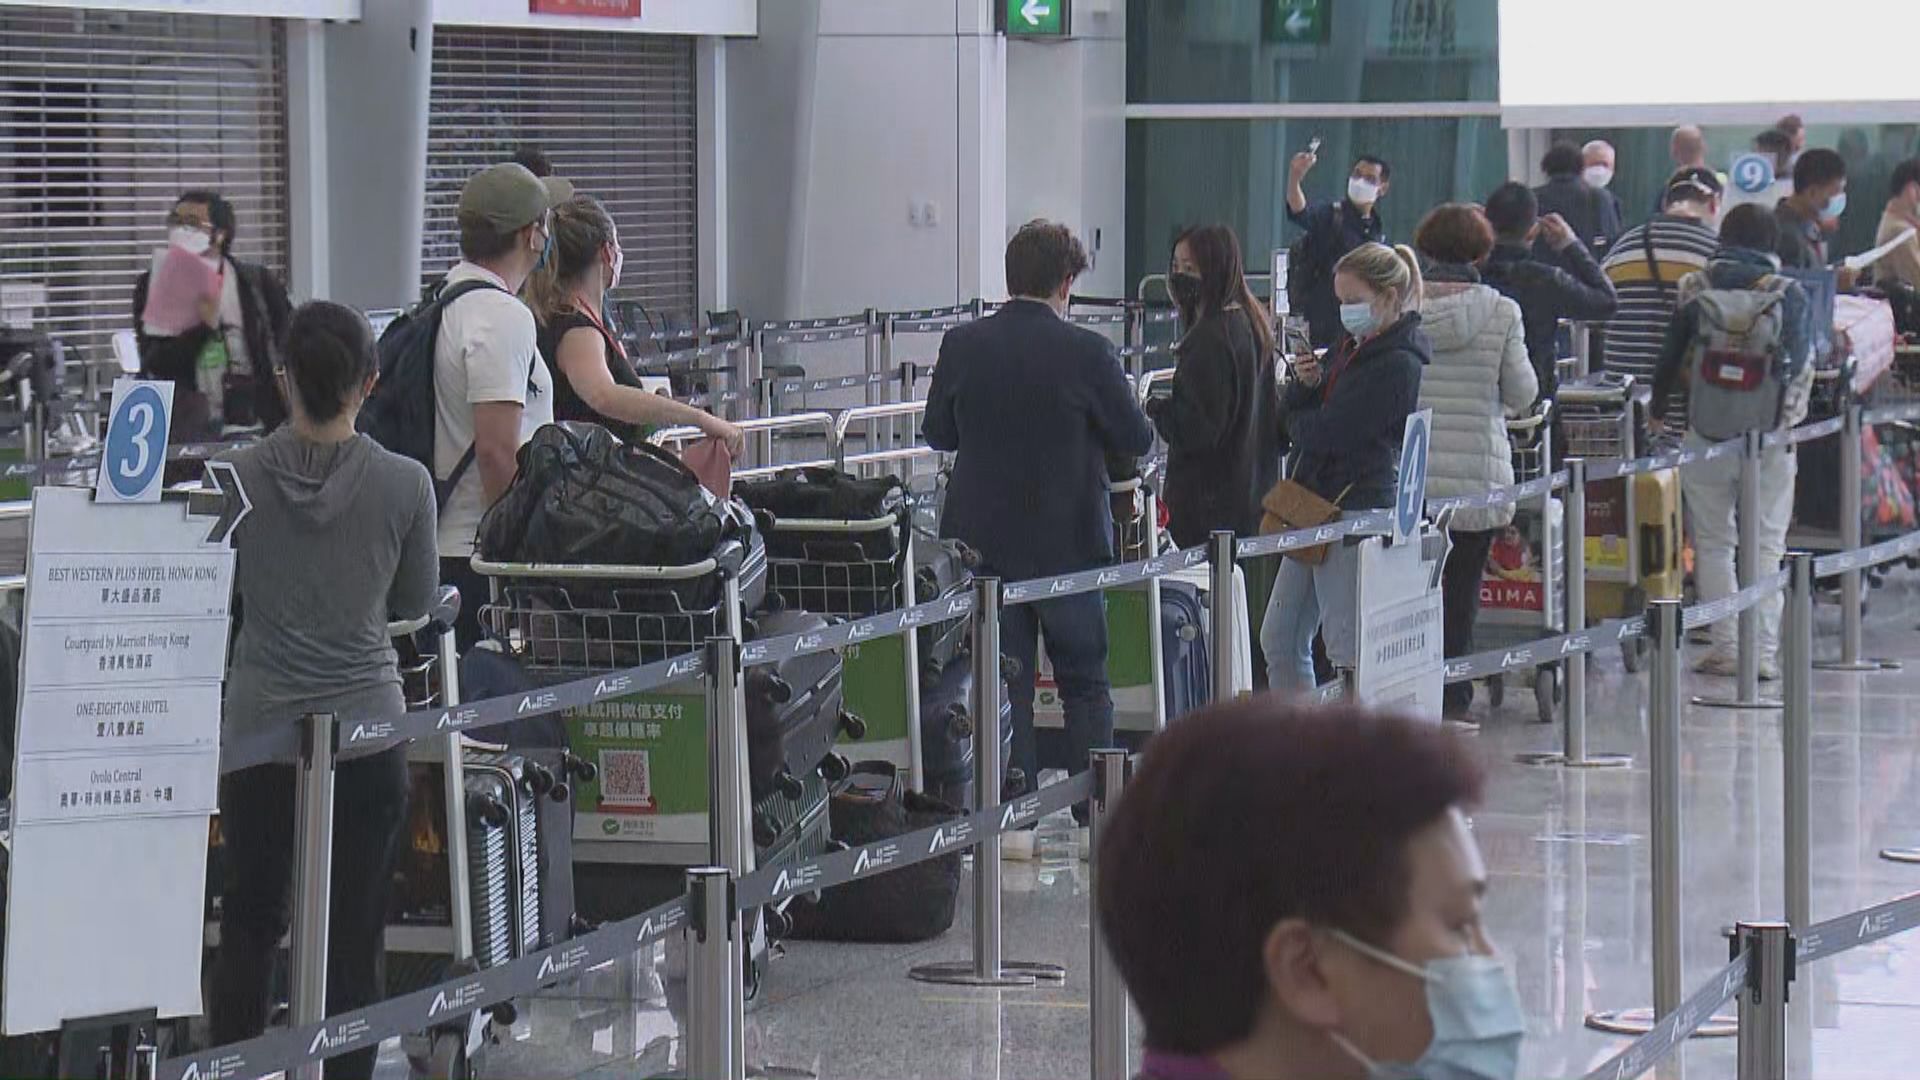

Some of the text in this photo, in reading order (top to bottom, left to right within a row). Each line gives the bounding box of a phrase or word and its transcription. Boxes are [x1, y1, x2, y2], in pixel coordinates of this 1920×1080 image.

[1742, 161, 1764, 190] 9
[119, 402, 155, 478] 3
[1403, 434, 1421, 514] 4
[48, 565, 218, 582] BEST WESTERN PLUS HOTEL HONG KONG
[1479, 588, 1537, 602] QIMA
[64, 631, 190, 653] Courtyard by Marriott Hong Kong
[76, 700, 169, 716] ONE-EIGHT-ONE HOTEL
[90, 767, 142, 785] Ovolo Central
